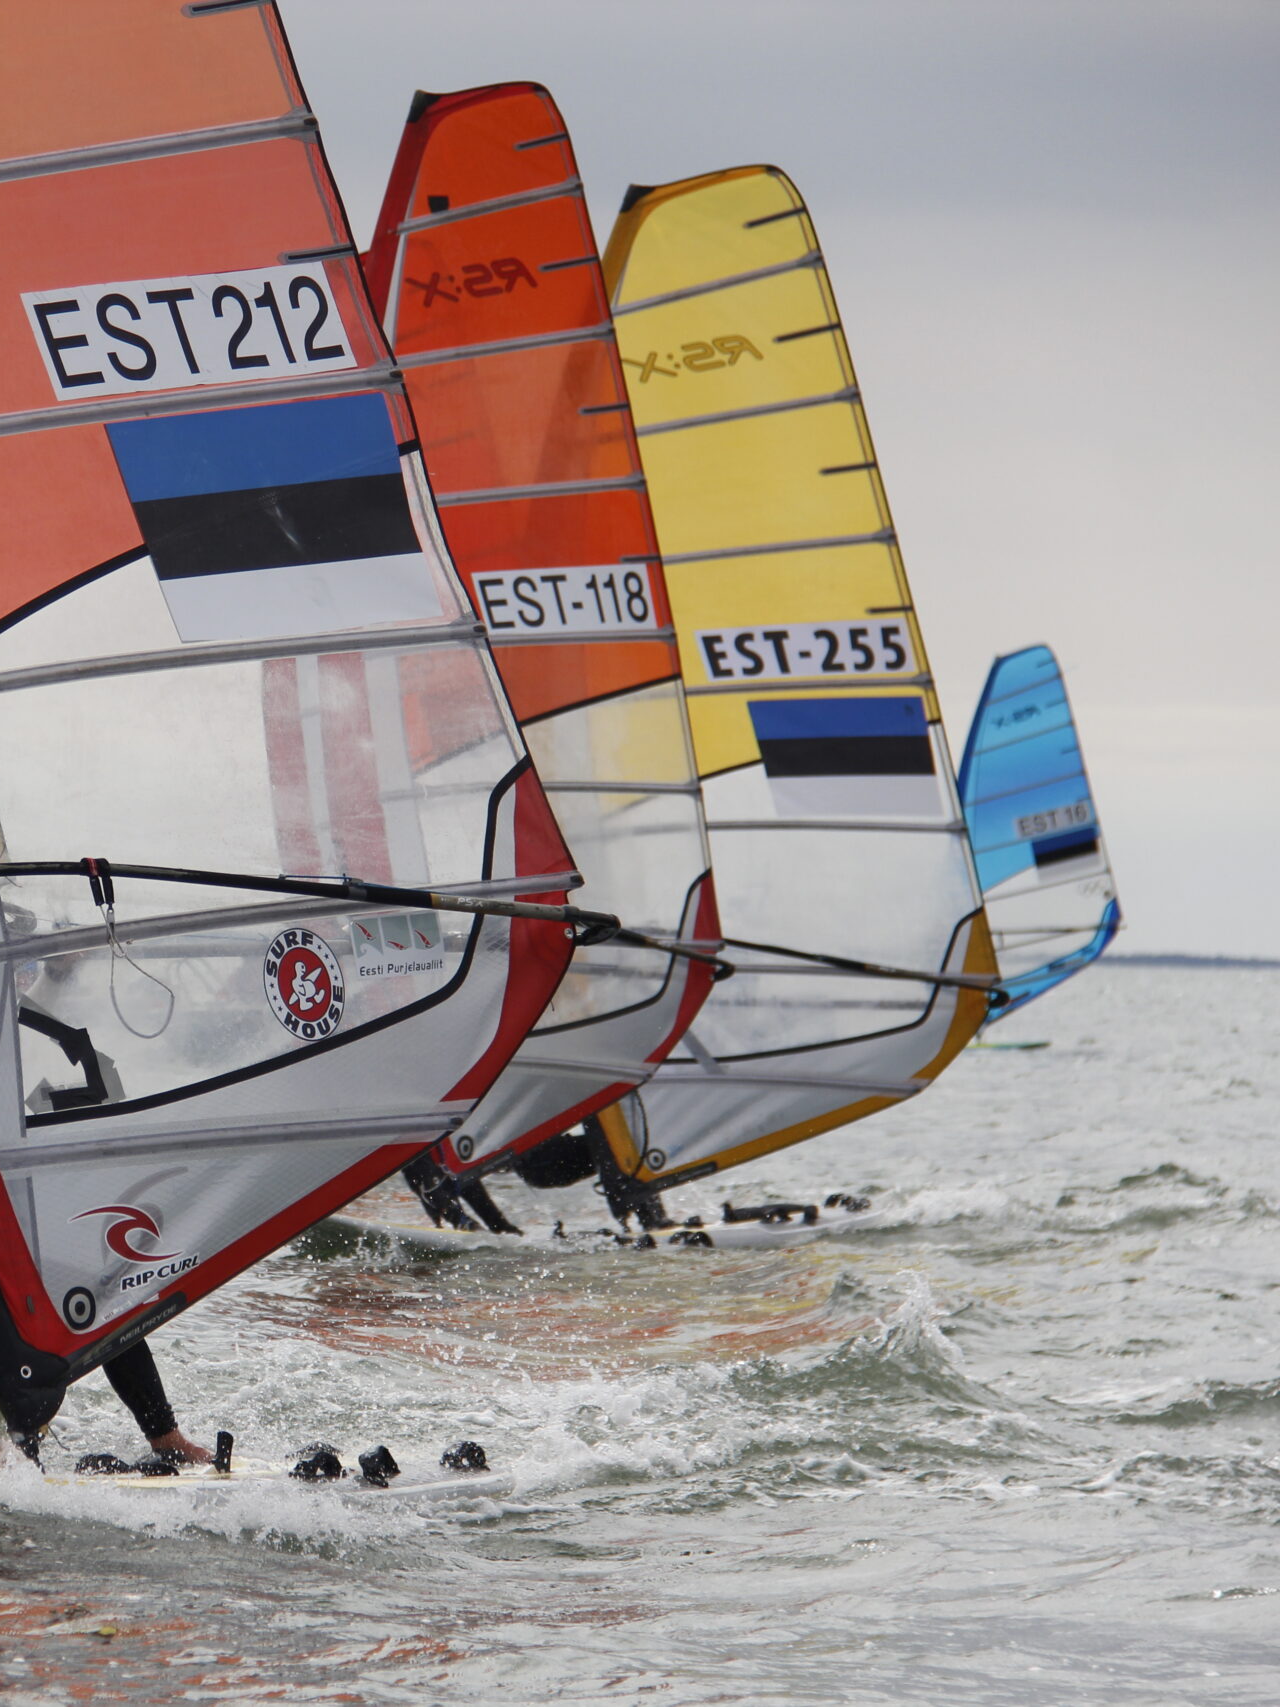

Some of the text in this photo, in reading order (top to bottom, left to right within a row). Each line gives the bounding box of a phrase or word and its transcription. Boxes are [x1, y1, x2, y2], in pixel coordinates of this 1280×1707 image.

[478, 571, 649, 629] EST-118
[701, 626, 907, 679] EST-255
[1018, 811, 1057, 836] EST
[266, 930, 314, 978] SURF
[359, 959, 444, 977] Eesti Purjelaualiit
[283, 984, 344, 1039] HOUSE
[121, 1255, 200, 1291] RIP CURL
